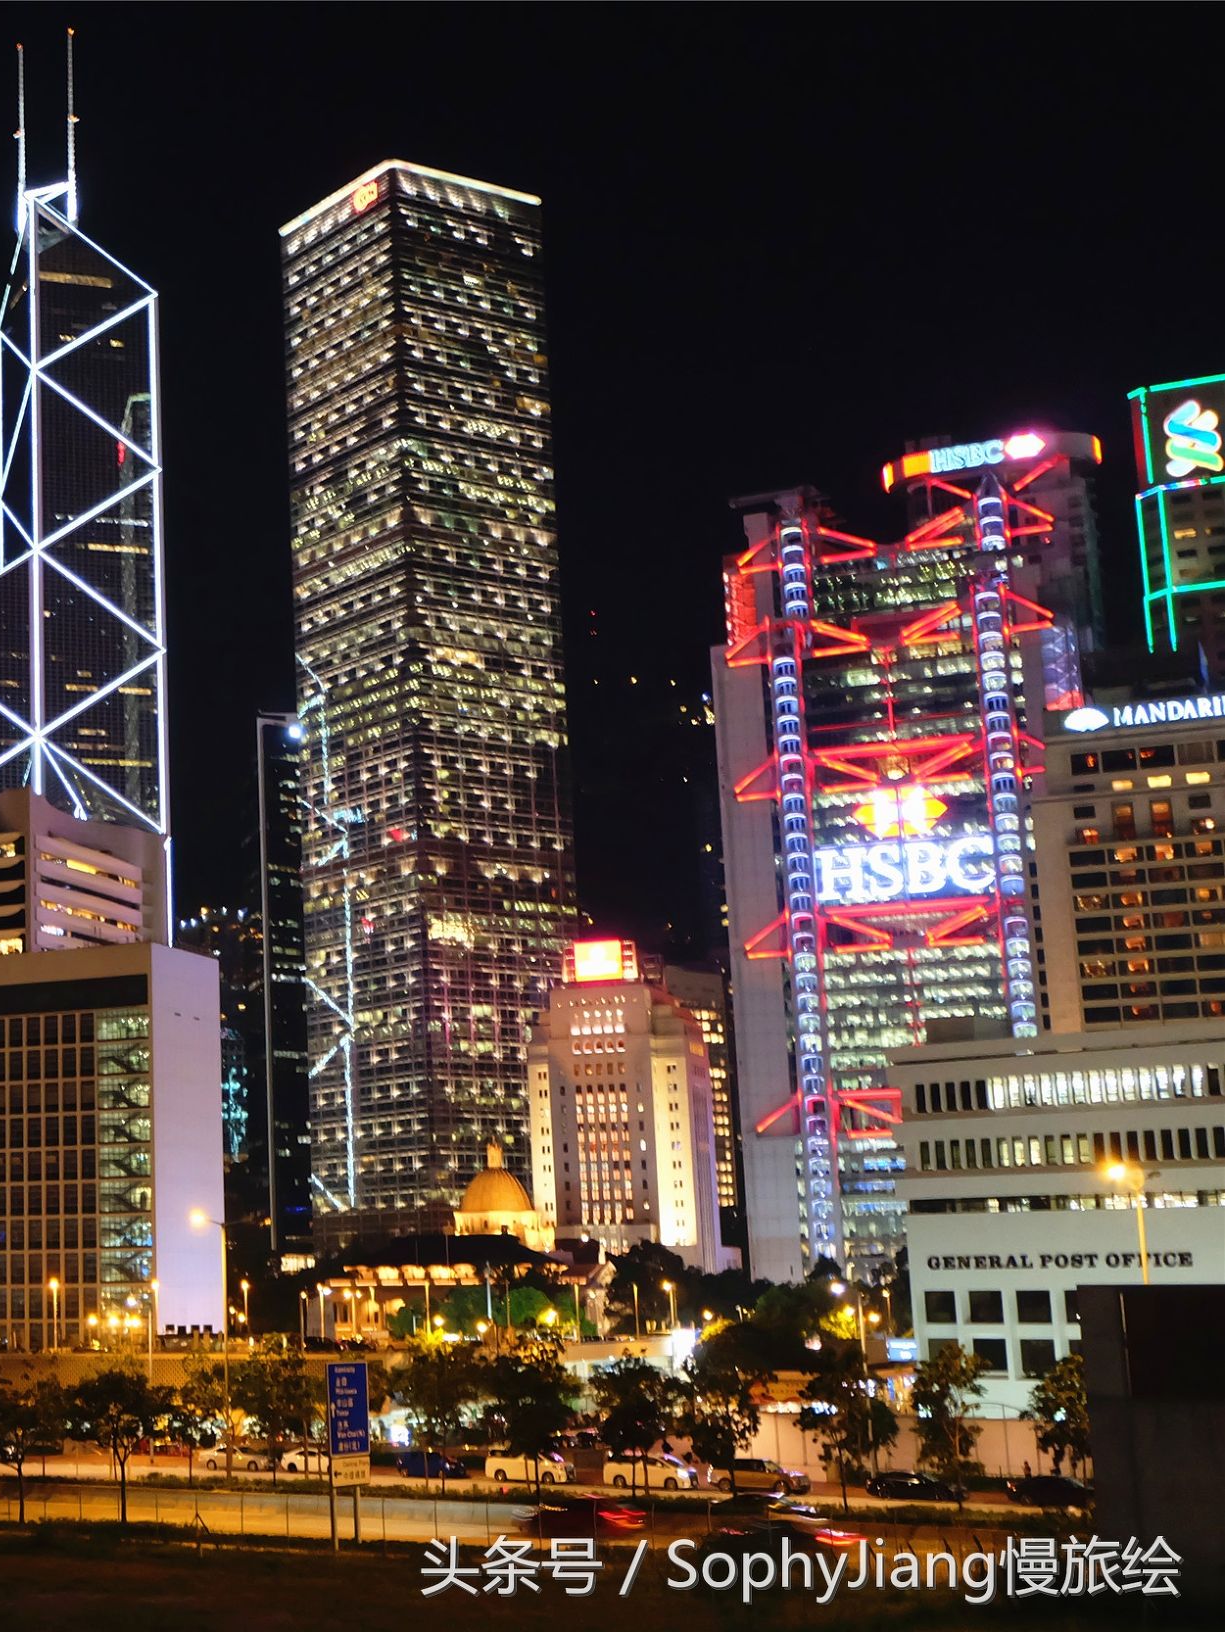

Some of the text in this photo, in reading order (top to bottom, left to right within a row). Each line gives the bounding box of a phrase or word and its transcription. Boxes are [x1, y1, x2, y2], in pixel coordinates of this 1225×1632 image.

[931, 439, 1006, 473] HSBC
[1113, 695, 1225, 727] MANDARI
[815, 835, 996, 901] HSBC
[927, 1254, 1033, 1270] GENERAL
[1039, 1253, 1098, 1268] POST
